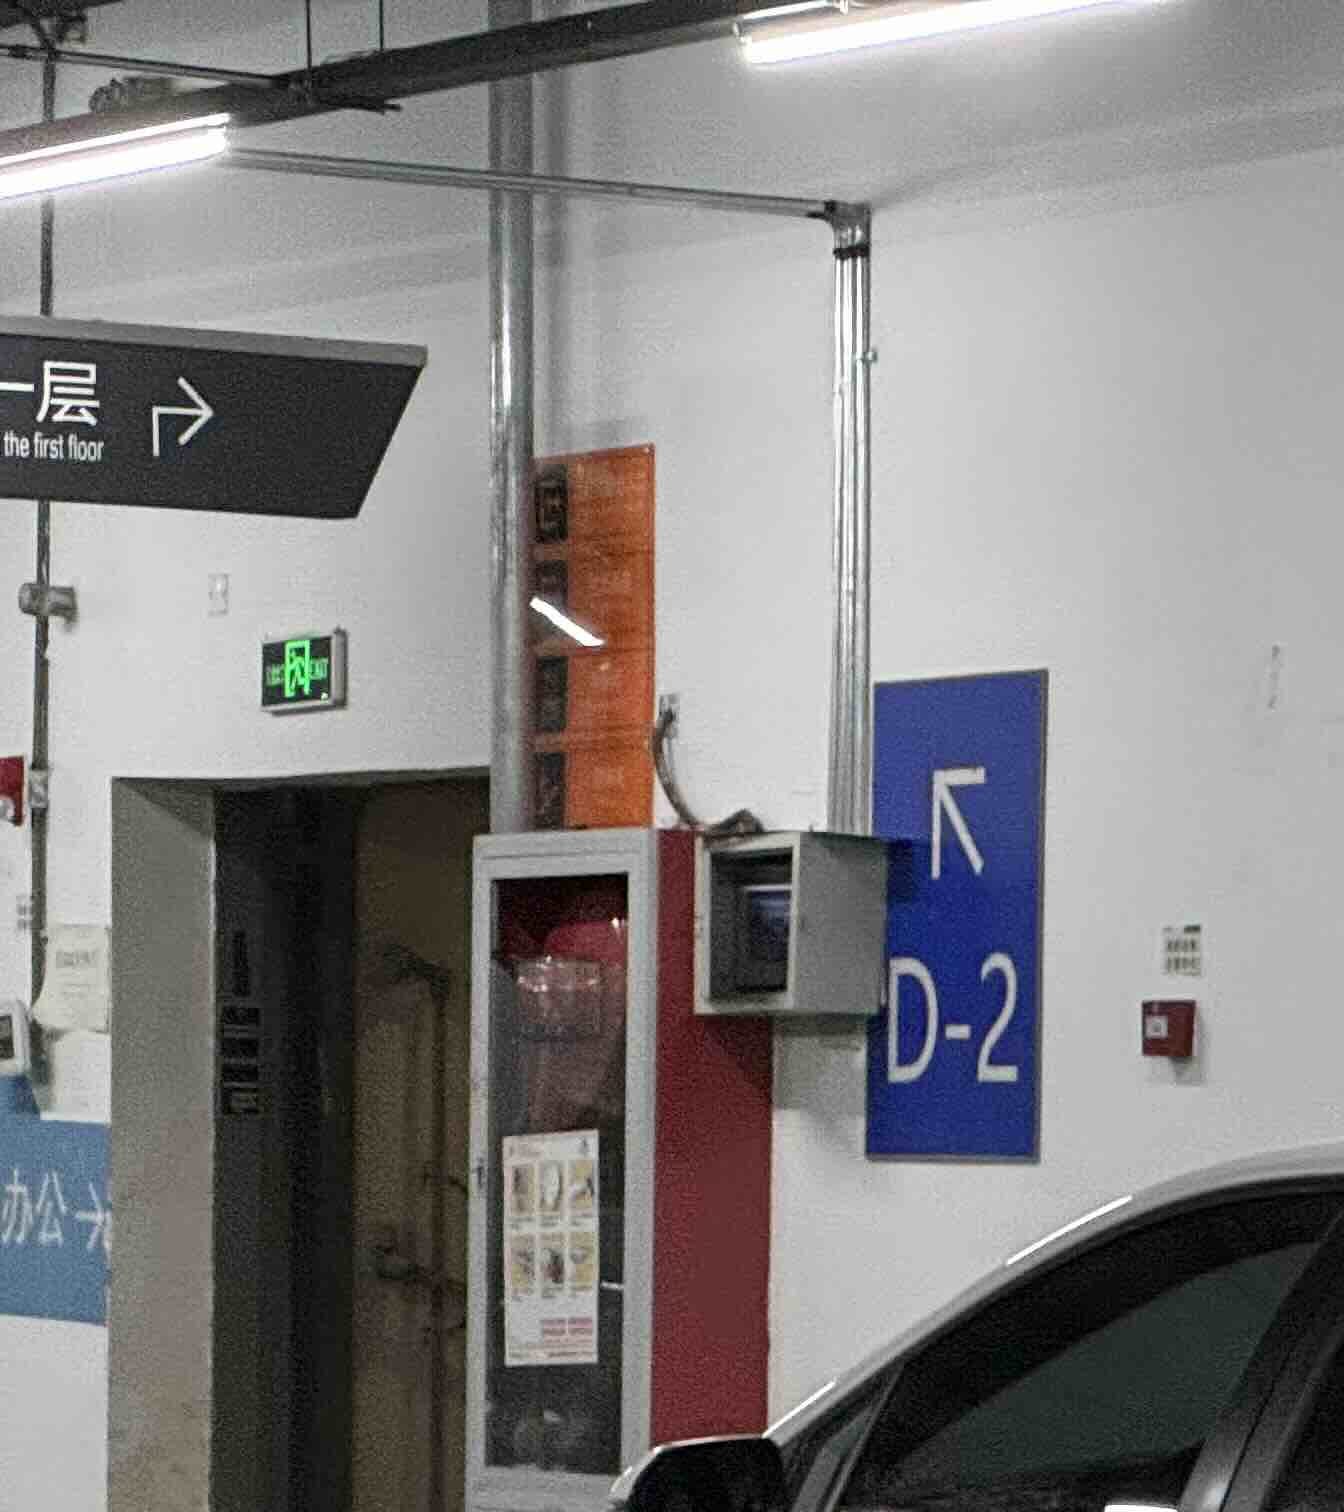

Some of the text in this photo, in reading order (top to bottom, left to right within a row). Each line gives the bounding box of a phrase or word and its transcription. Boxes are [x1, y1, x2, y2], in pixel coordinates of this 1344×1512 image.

[3, 430, 104, 462] the first floor
[887, 951, 1018, 1083] D-2
[0, 1168, 67, 1247] 办公
